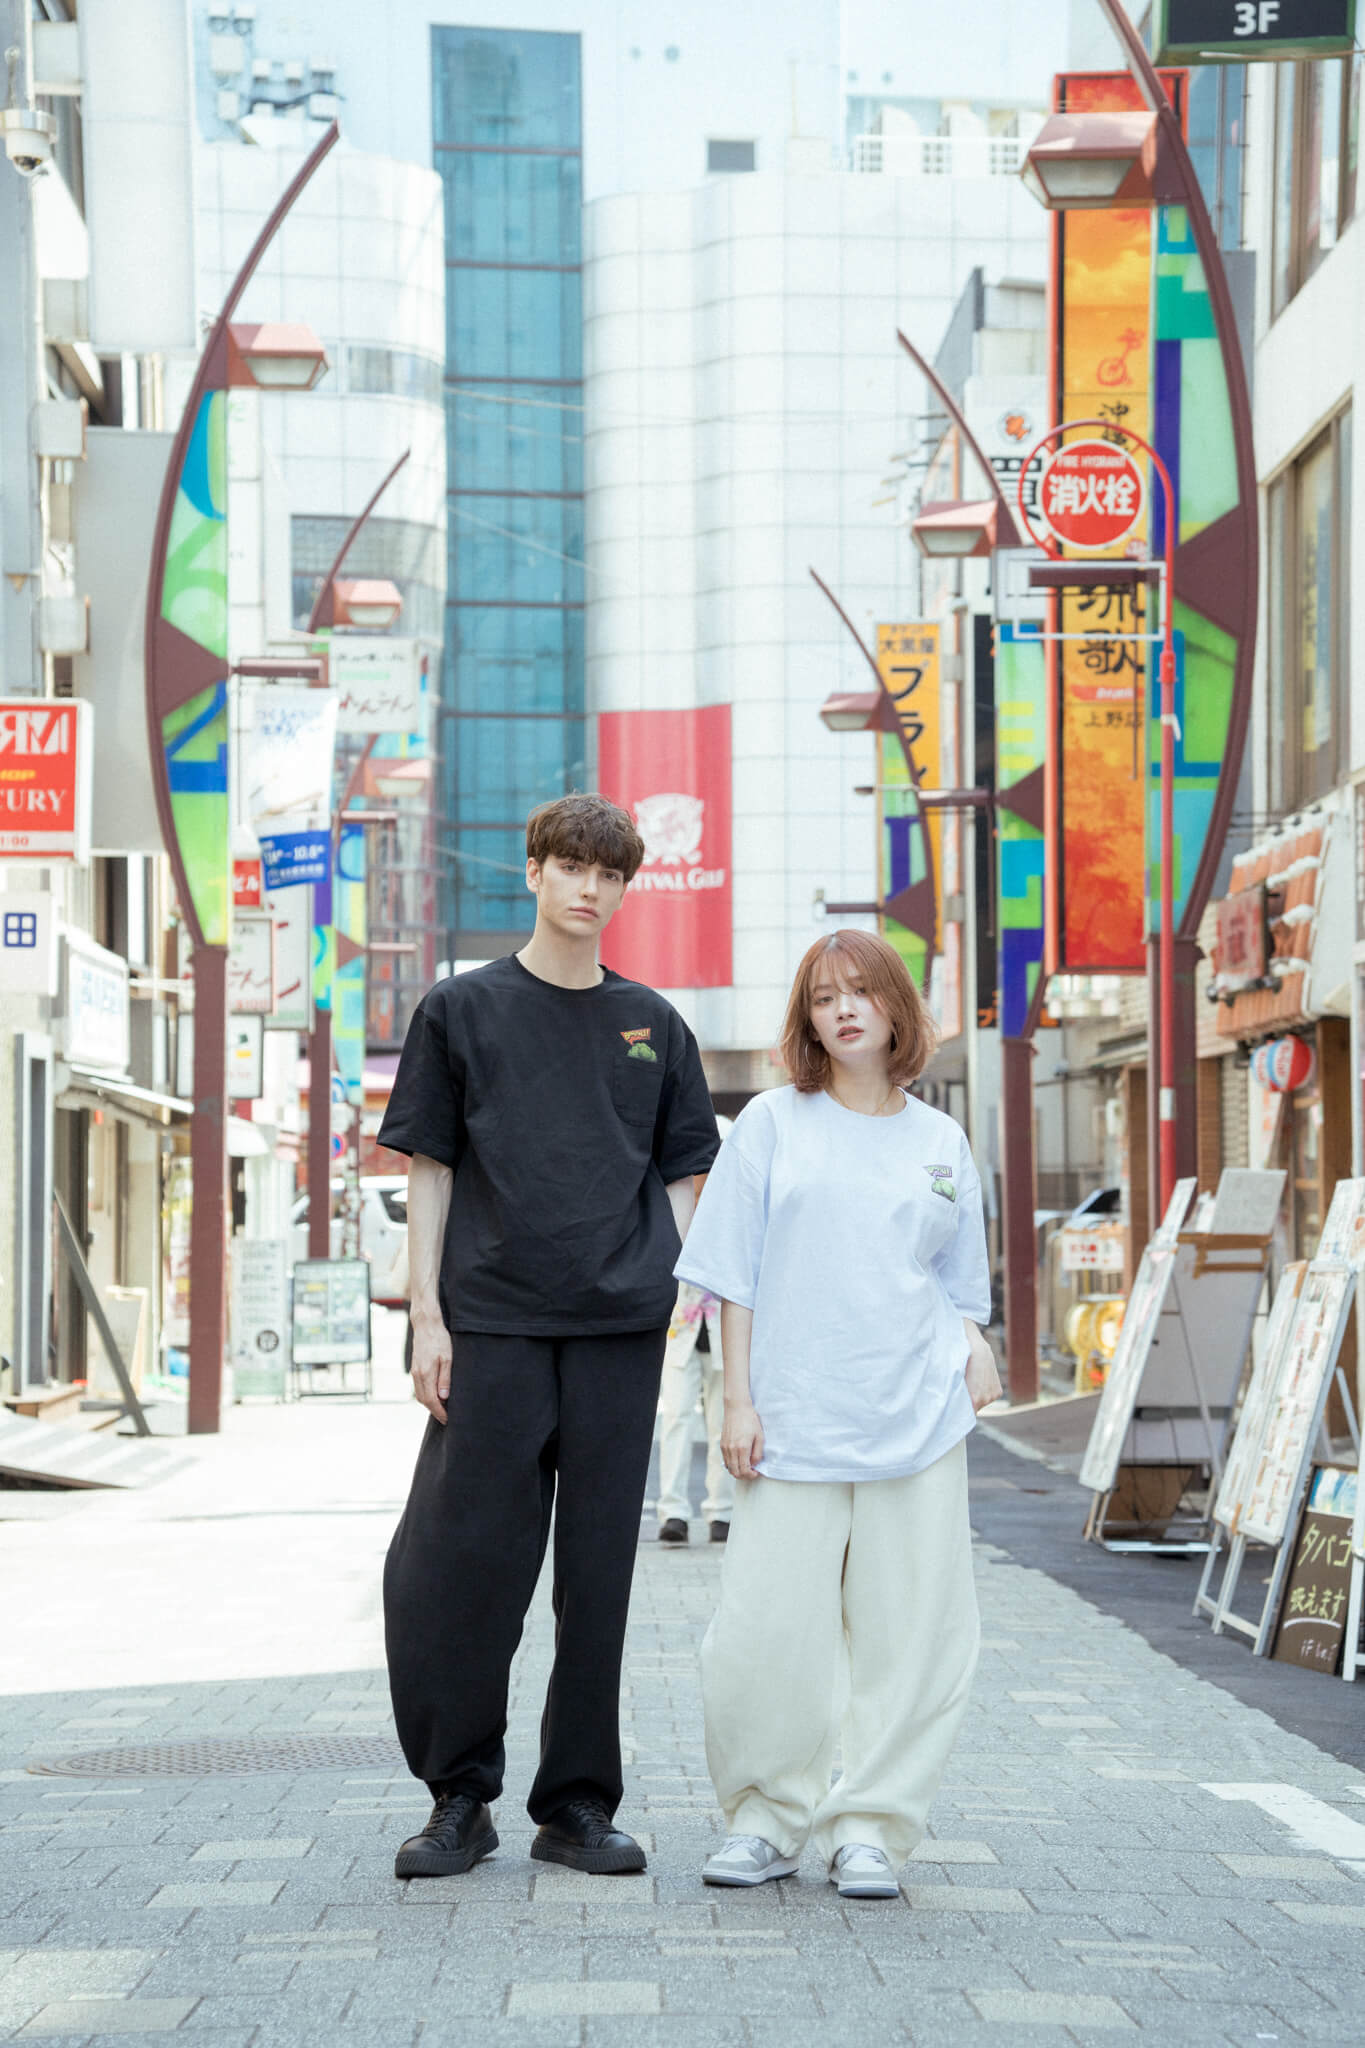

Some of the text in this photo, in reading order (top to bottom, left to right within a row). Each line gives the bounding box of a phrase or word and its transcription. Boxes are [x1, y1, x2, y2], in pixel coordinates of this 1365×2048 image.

[1233, 1, 1280, 36] 3F
[1049, 473, 1136, 516] 消火栓
[0, 789, 66, 815] URY
[1298, 1523, 1353, 1567] タバコ
